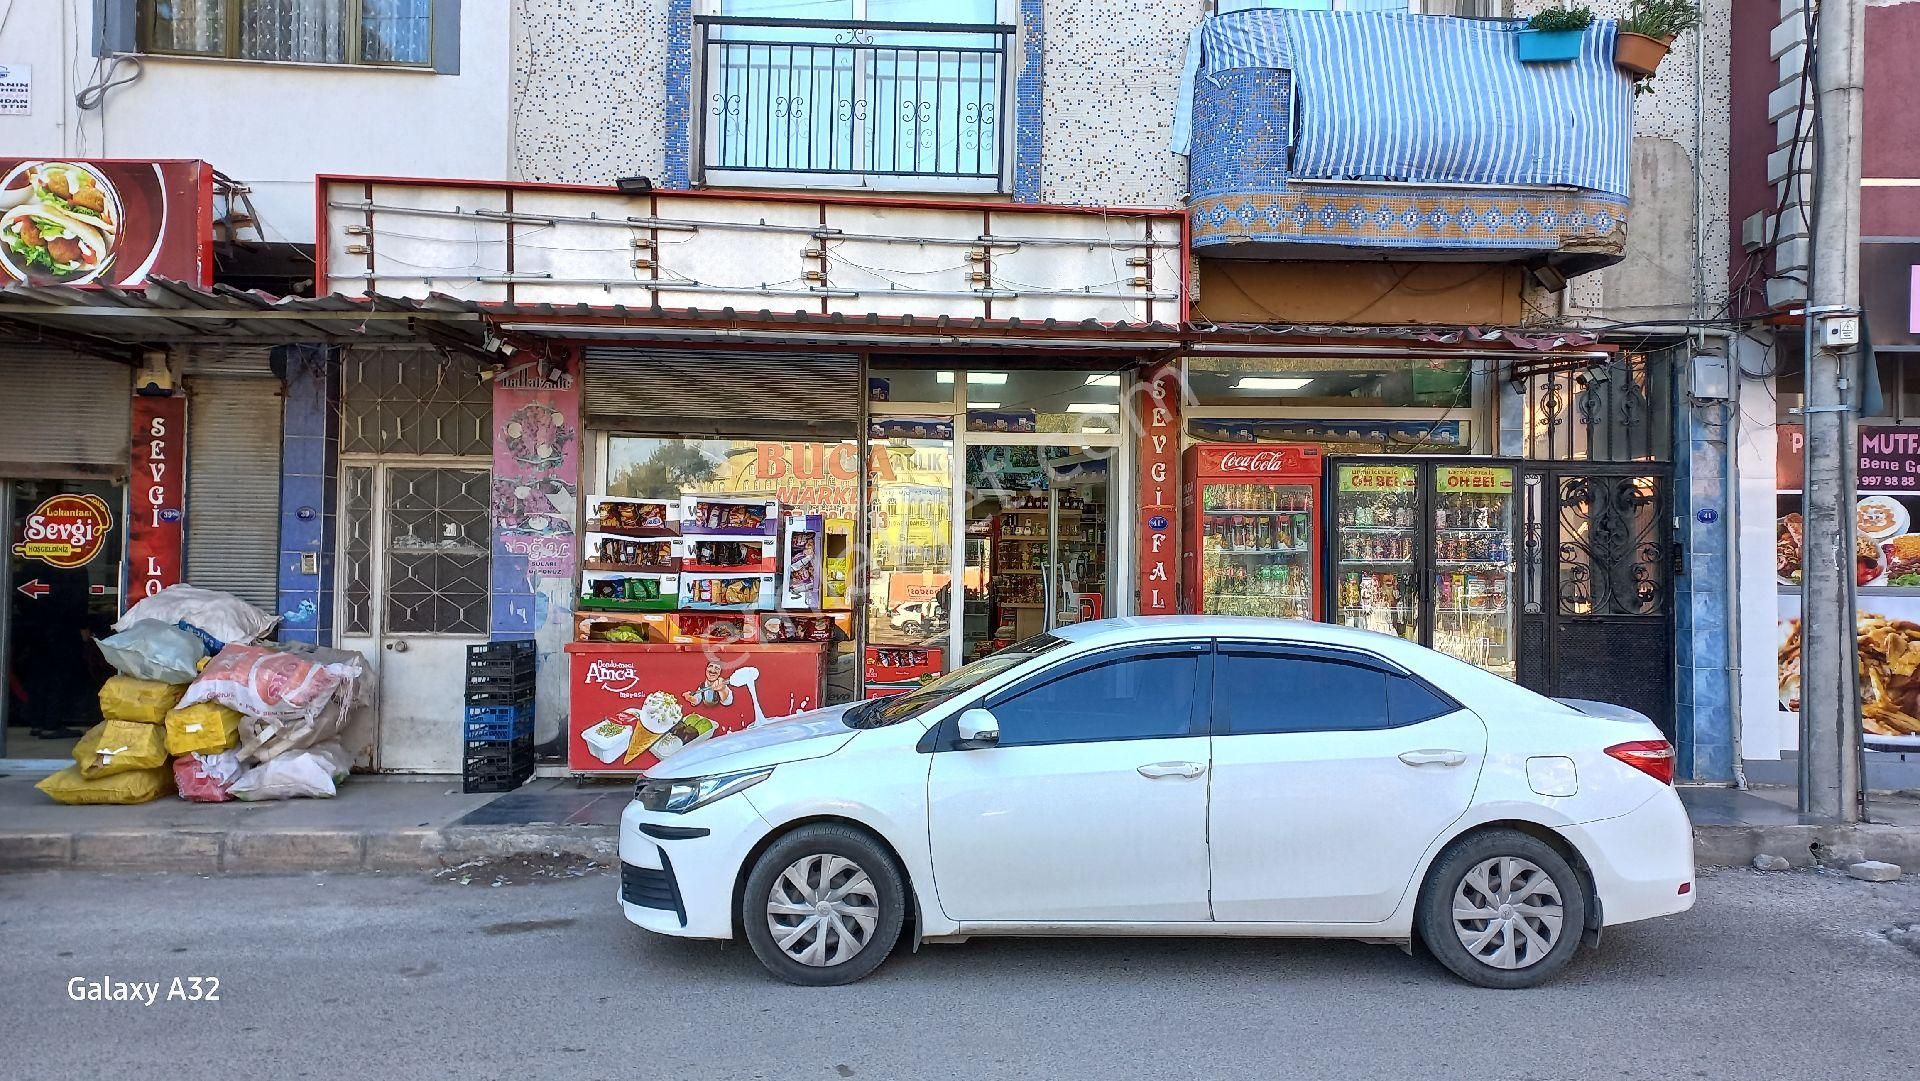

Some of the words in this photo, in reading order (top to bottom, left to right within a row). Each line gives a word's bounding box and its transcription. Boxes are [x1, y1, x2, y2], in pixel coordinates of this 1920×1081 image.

[1862, 433, 1920, 455] MUTF
[755, 443, 898, 481] BUCA
[1860, 457, 1900, 471] Bene
[1862, 476, 1882, 486] 997
[1884, 476, 1899, 486] 98
[1901, 476, 1916, 487] 88
[27, 515, 94, 546] Sevgi
[584, 662, 636, 684] Amca
